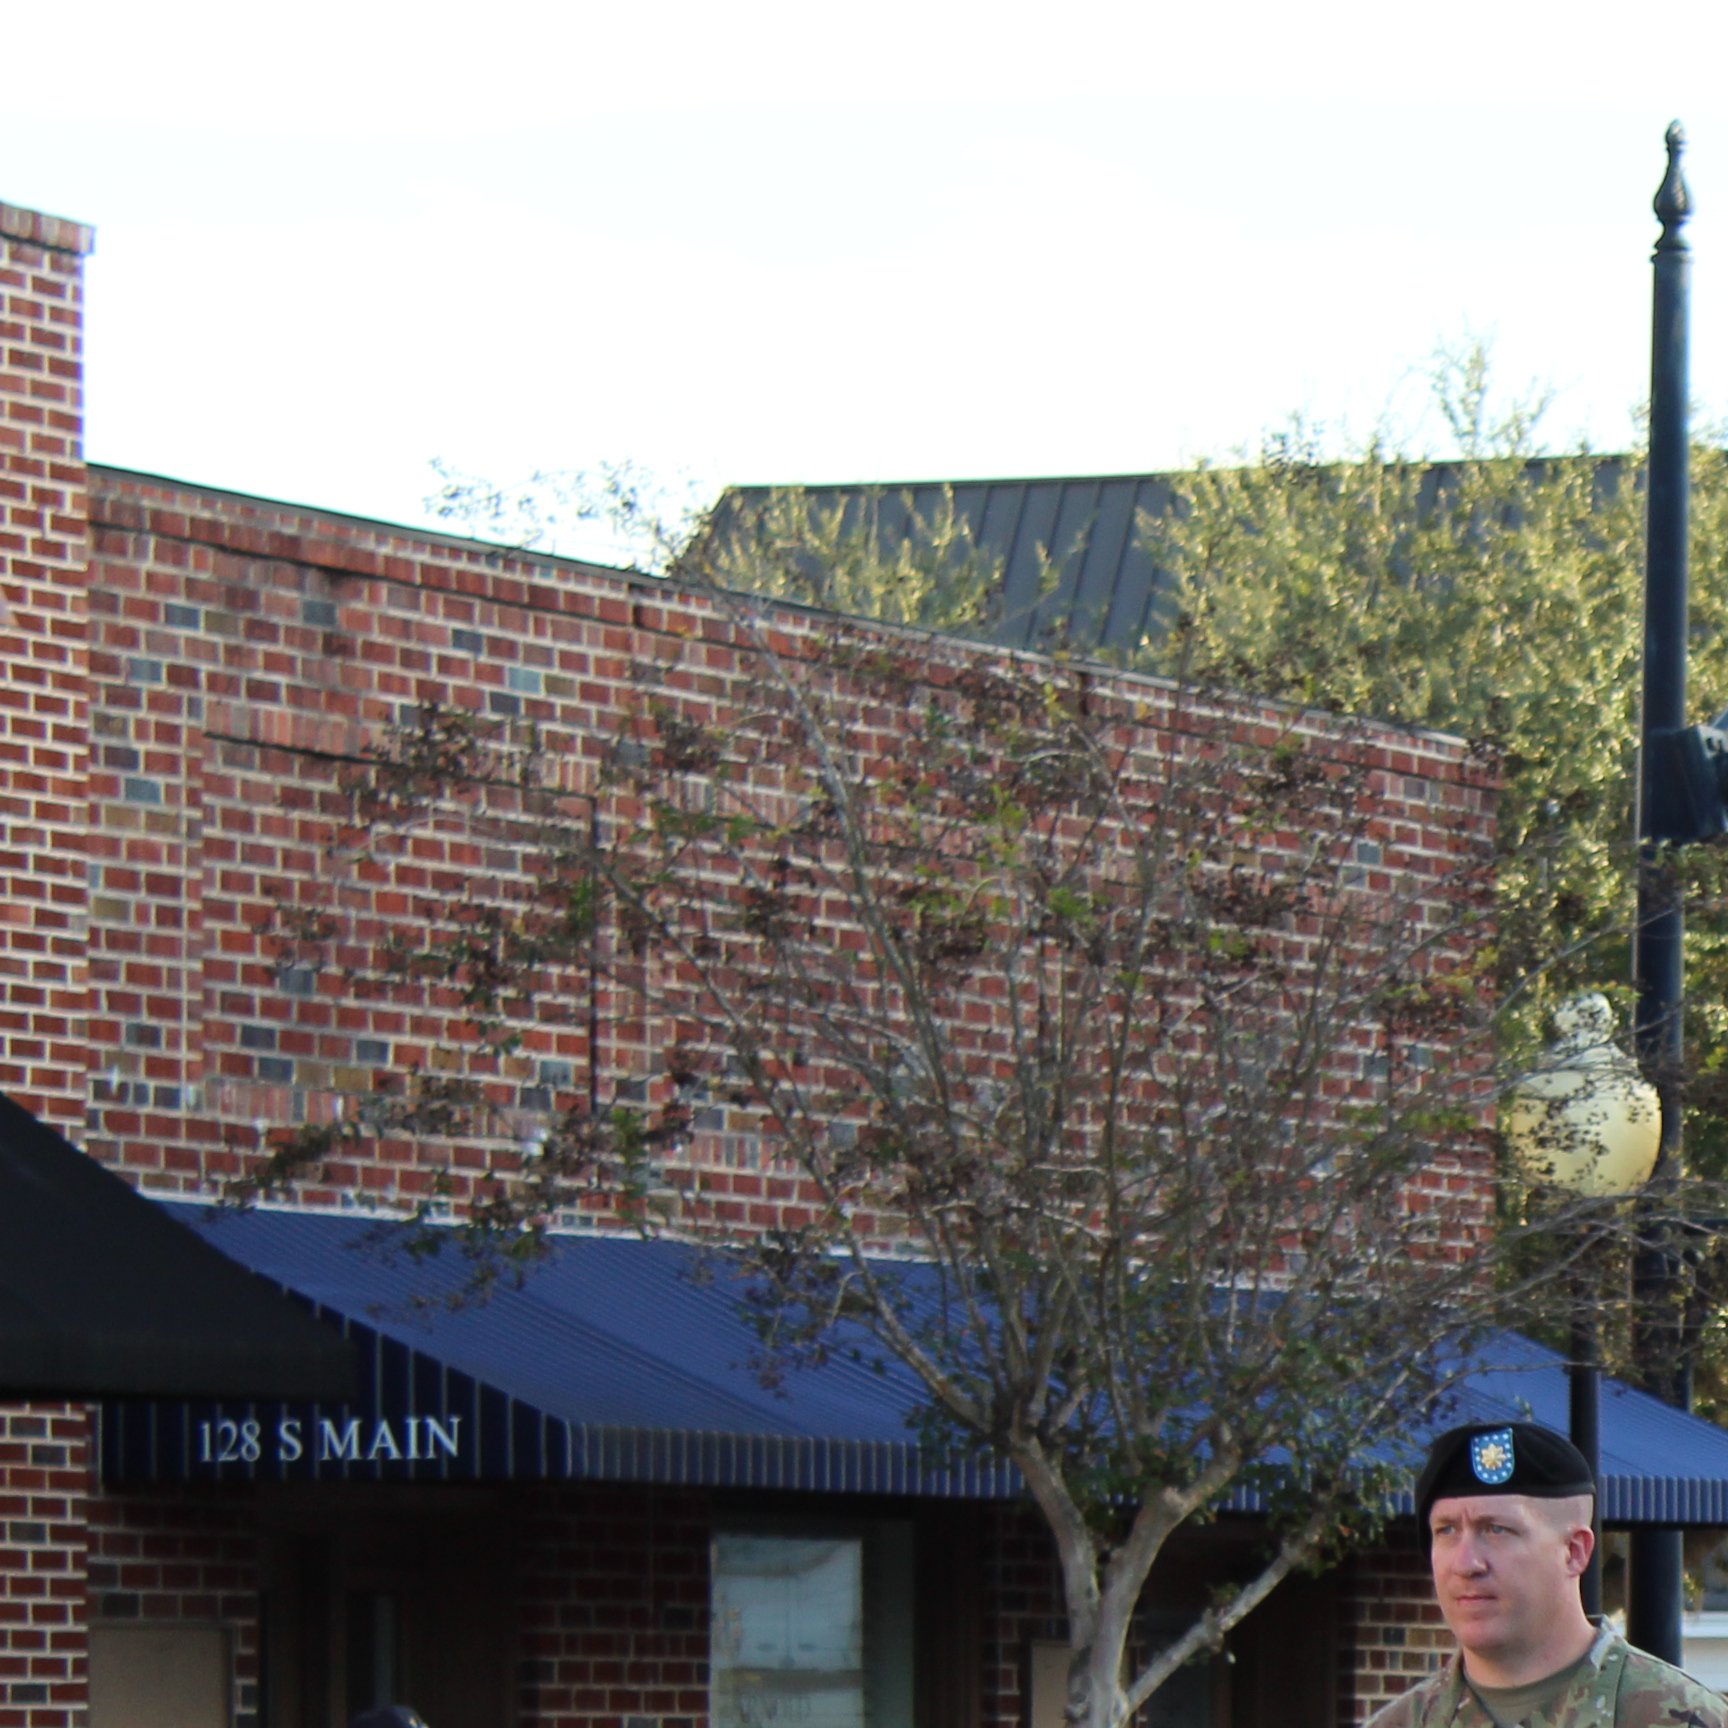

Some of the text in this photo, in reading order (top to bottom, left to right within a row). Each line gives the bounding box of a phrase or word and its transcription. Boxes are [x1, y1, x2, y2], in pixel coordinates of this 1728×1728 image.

[200, 1414, 463, 1462] 128 S MAIN
